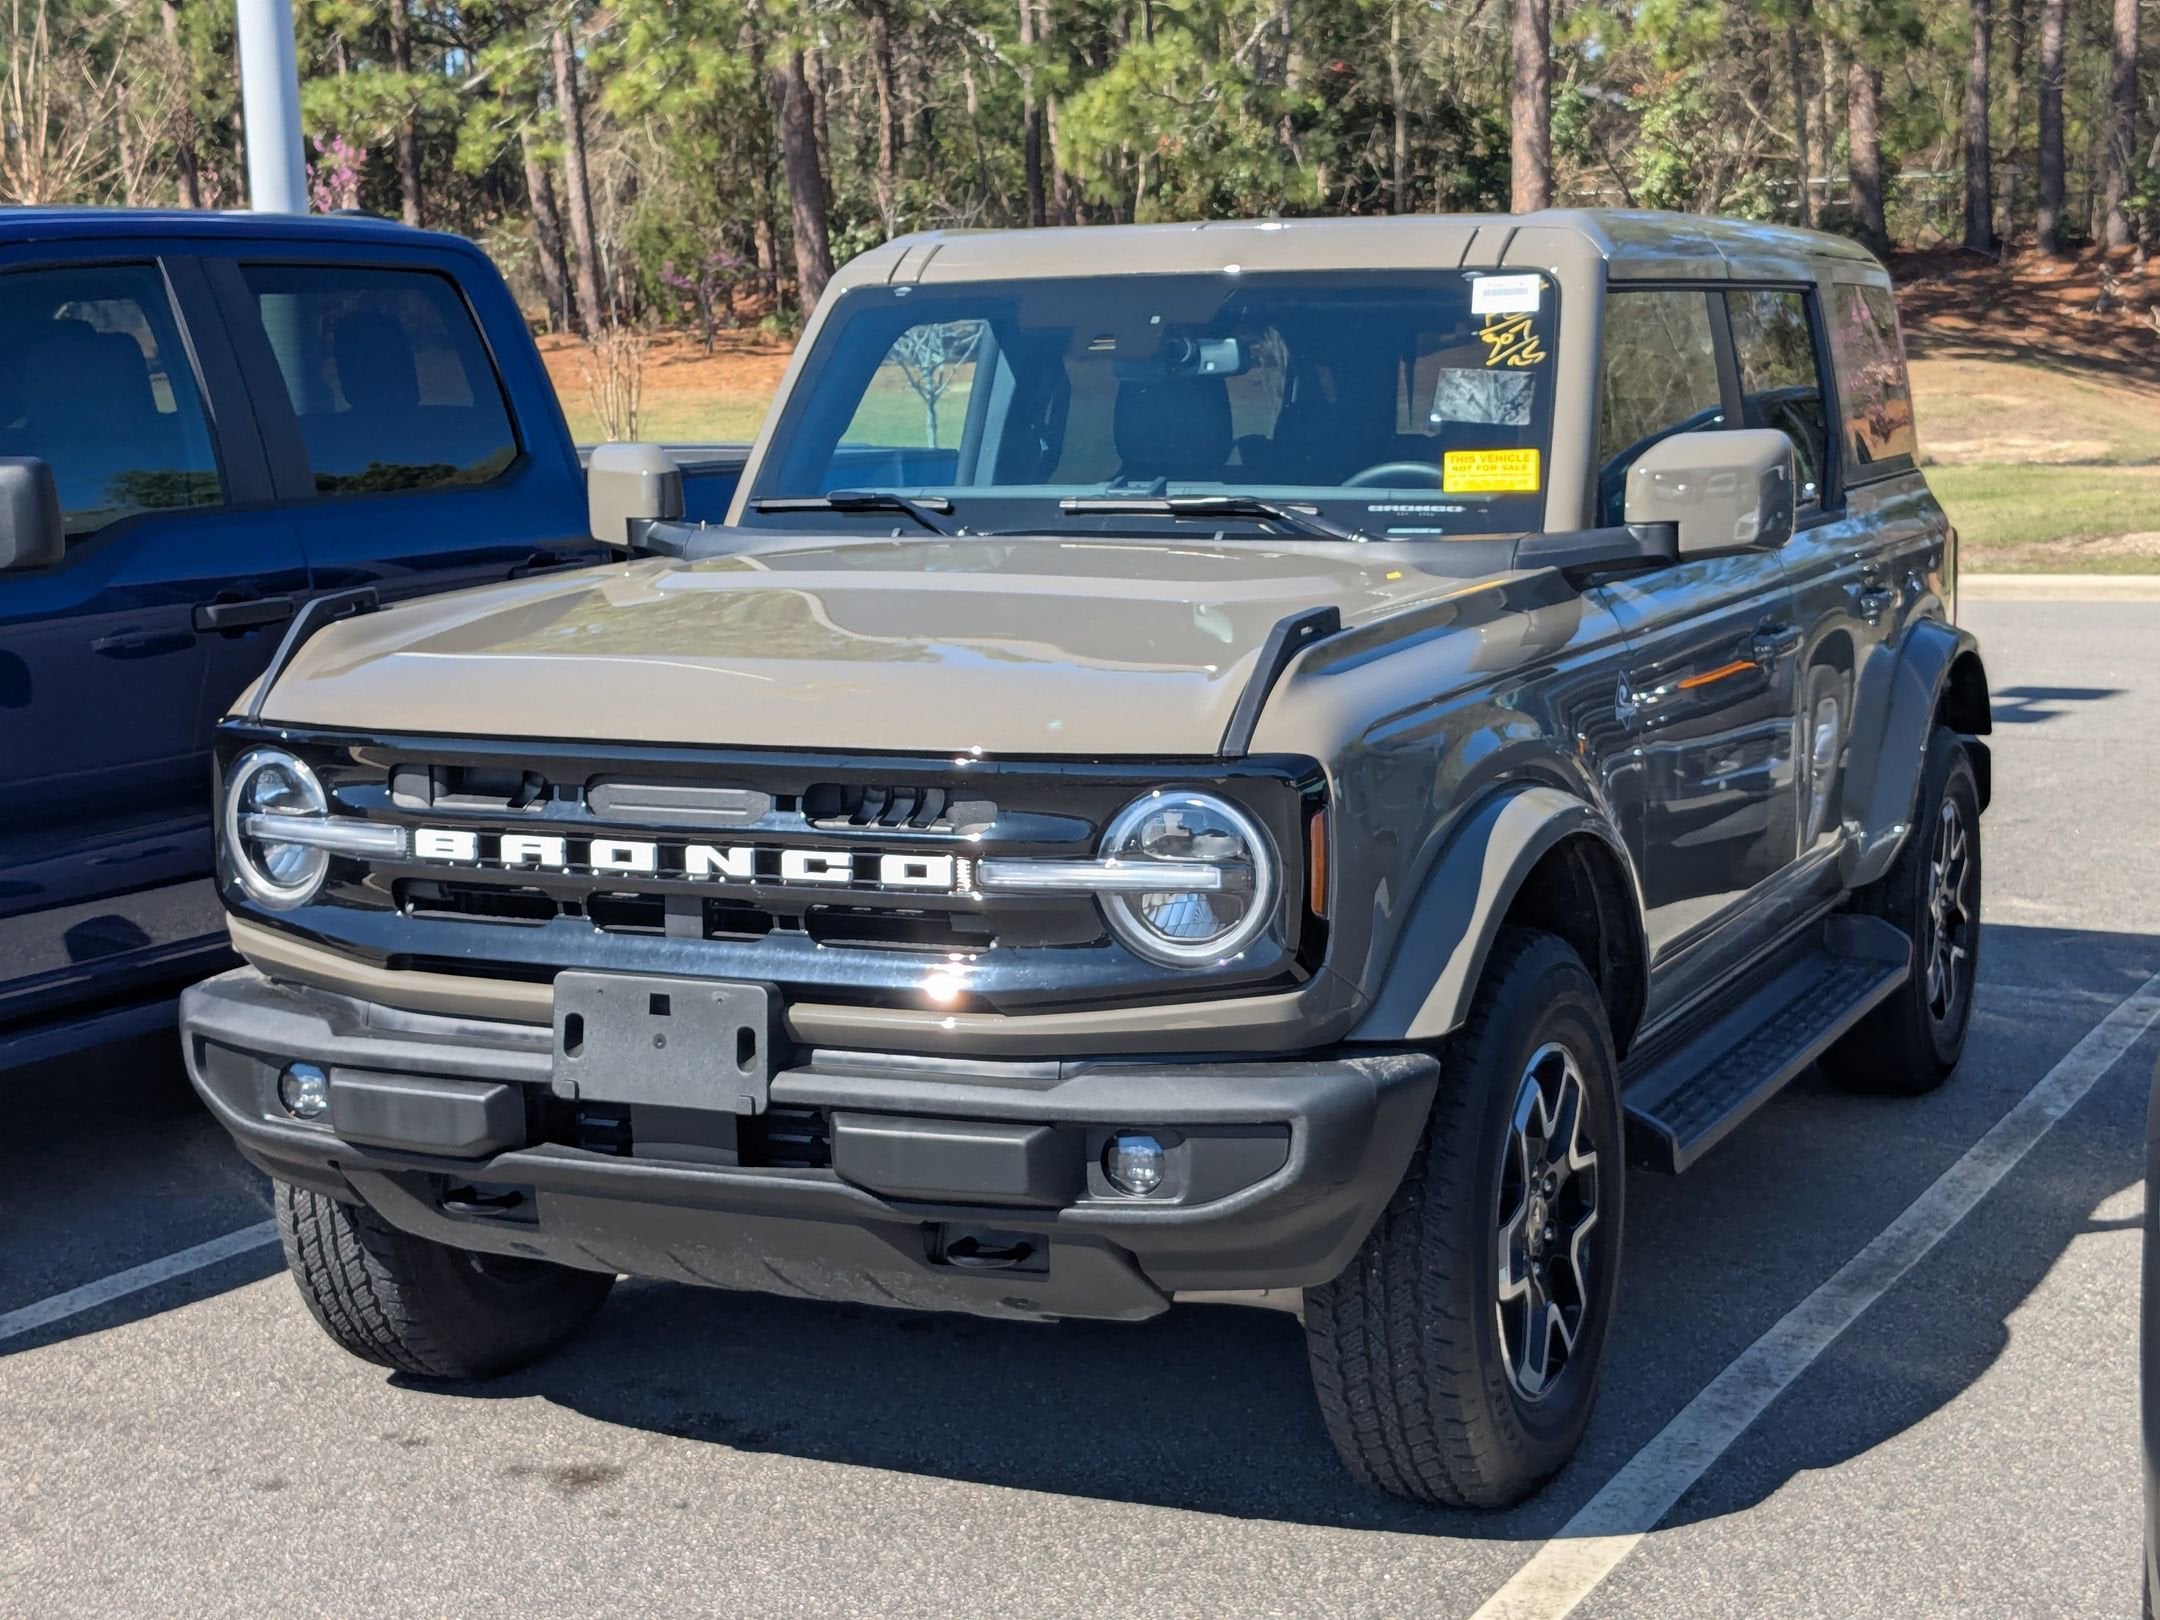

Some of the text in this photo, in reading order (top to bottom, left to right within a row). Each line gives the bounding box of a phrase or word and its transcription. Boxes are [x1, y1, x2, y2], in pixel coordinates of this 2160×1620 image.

[1449, 452, 1531, 464] THIS VEHICLE
[1452, 465, 1473, 473] NOT
[1502, 463, 1528, 471] SALE
[415, 828, 953, 887] BRONCO
